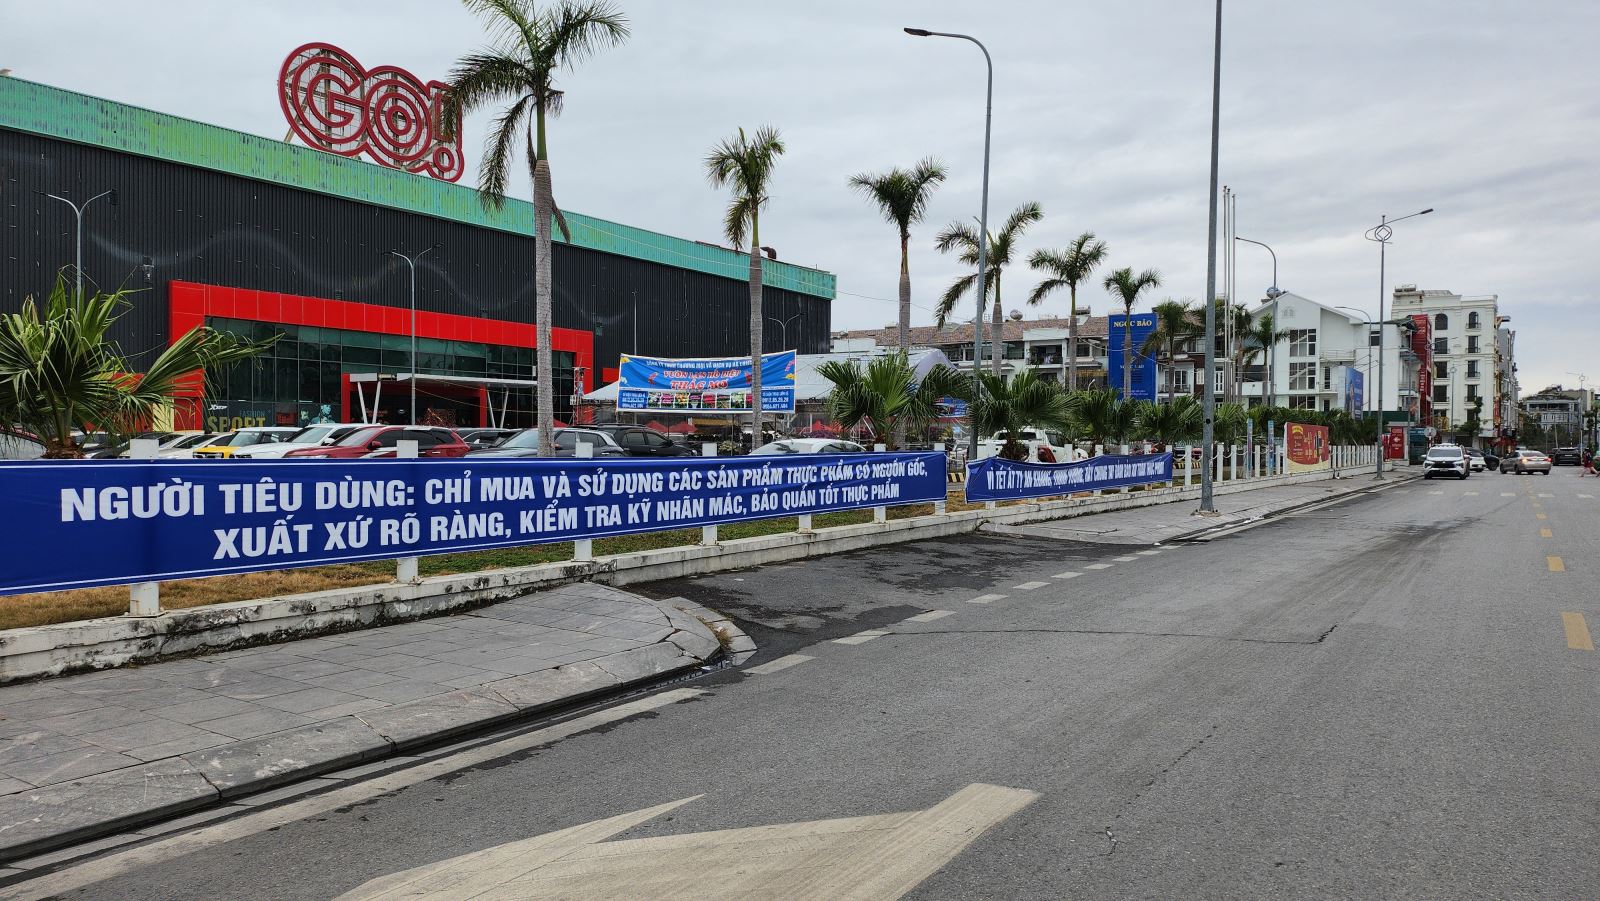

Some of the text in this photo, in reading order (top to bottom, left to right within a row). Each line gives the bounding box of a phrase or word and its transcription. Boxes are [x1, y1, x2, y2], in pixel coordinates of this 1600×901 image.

[278, 42, 464, 182] GO!
[61, 478, 205, 522] NGƯỜI
[219, 477, 303, 515] TIÊU
[316, 476, 415, 510] DÙNG:
[426, 470, 472, 505] CHỈ
[480, 476, 536, 502] MUA
[542, 470, 572, 499] VÀ
[578, 467, 608, 497] SỬ
[613, 471, 664, 499] DỤNG
[668, 467, 703, 492] CÁC
[706, 464, 739, 489] SẢN
[742, 461, 784, 487] PHẨM
[855, 459, 871, 480] CÓ
[907, 457, 928, 477] GỐC,
[987, 467, 994, 490] VÌ
[996, 465, 1006, 489] TẾT
[1007, 465, 1017, 489] ẤT
[213, 514, 313, 560] XUẤT
[323, 514, 373, 551] XỨ
[380, 512, 420, 546] RÕ
[430, 509, 512, 542] RÀNG,
[520, 499, 578, 534] KIỂM
[584, 504, 622, 528] TRA
[627, 498, 653, 525] KỸ
[656, 495, 704, 522] NHÃN
[708, 492, 747, 520] MÁC,
[752, 487, 779, 512] BẢO
[818, 482, 840, 506] TỐT
[841, 485, 869, 508] THỰC
[871, 477, 900, 501] PHẨM
